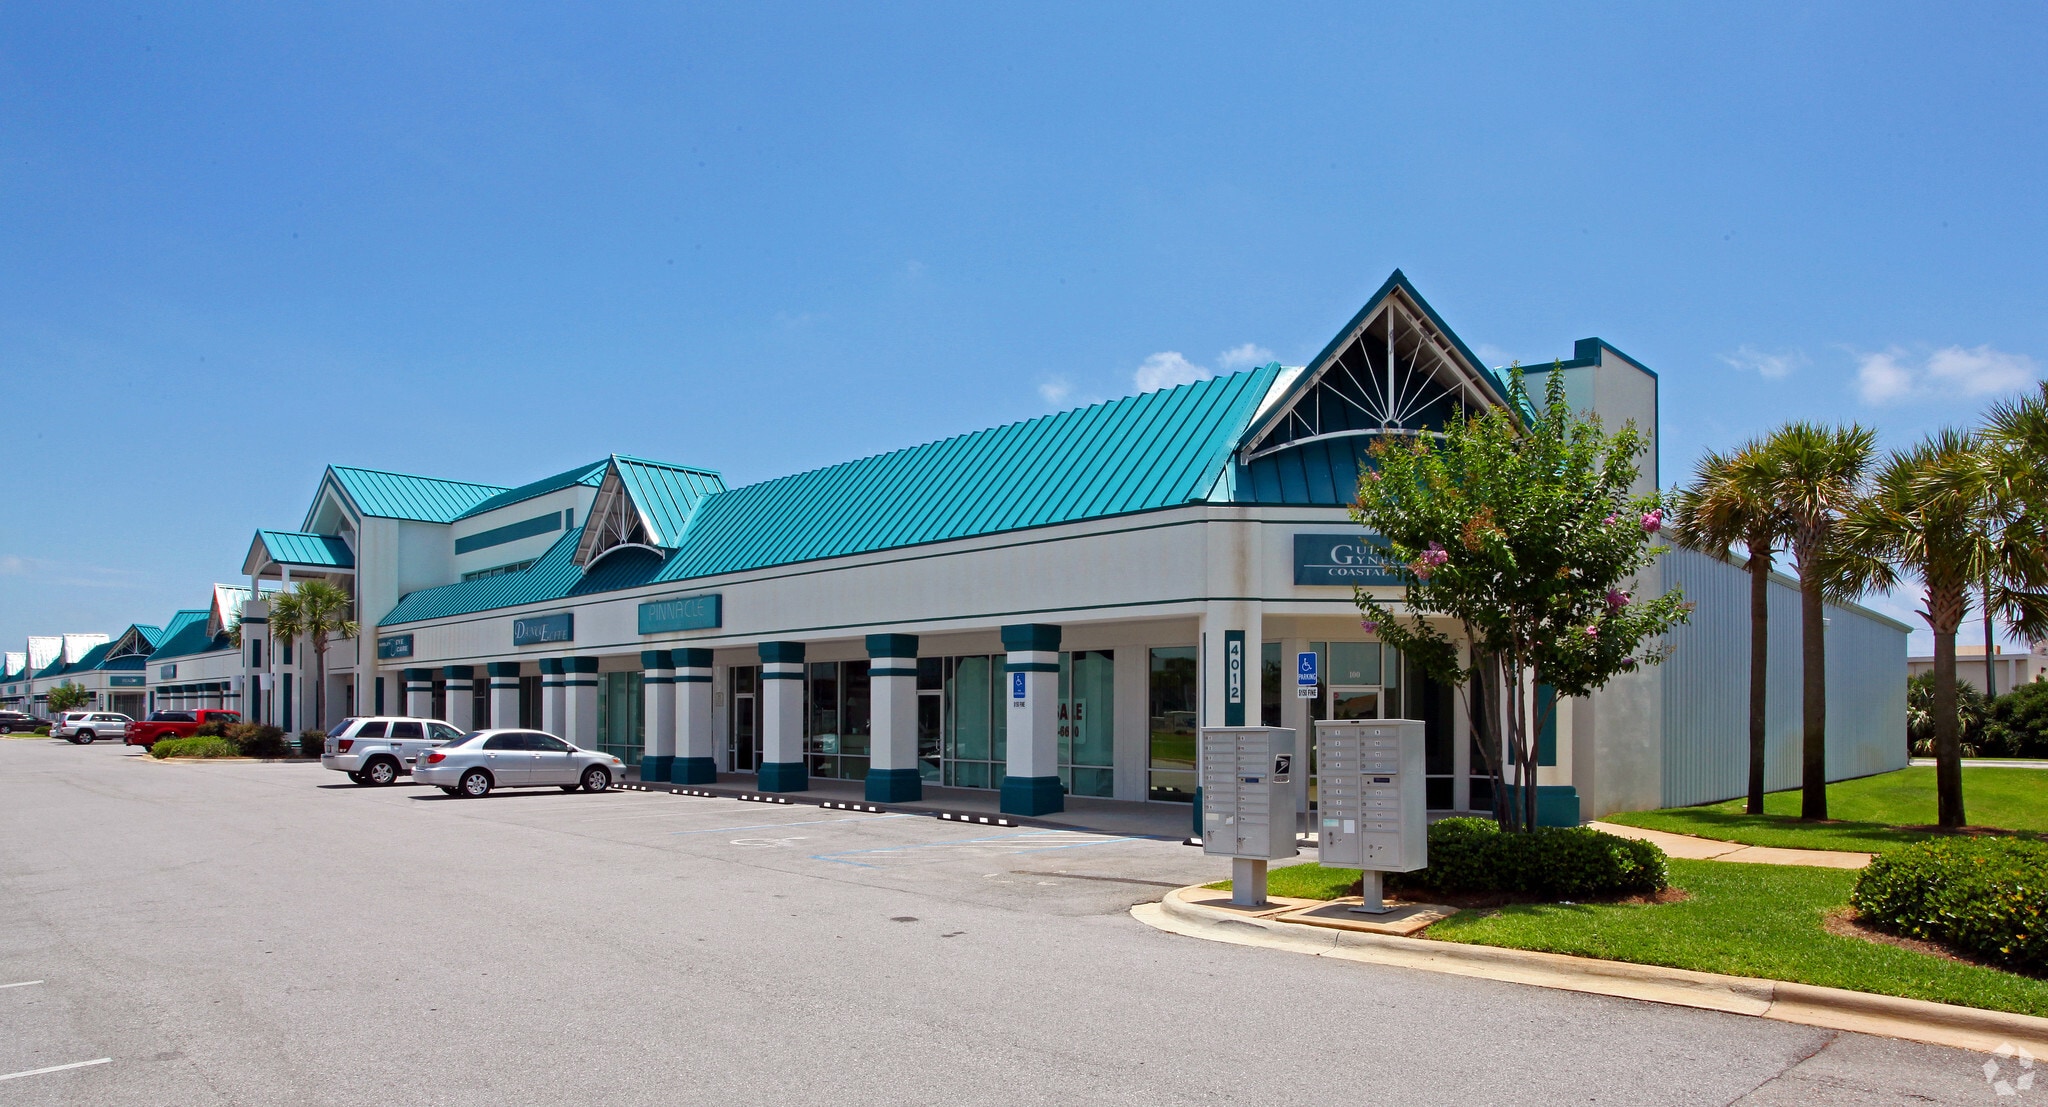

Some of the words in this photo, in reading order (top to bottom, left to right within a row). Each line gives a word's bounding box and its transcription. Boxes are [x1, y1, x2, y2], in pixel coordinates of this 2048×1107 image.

[1328, 568, 1390, 576] COASTAL
[649, 600, 704, 620] PINNACLE
[1230, 645, 1240, 698] 4012
[1058, 703, 1082, 720] AE
